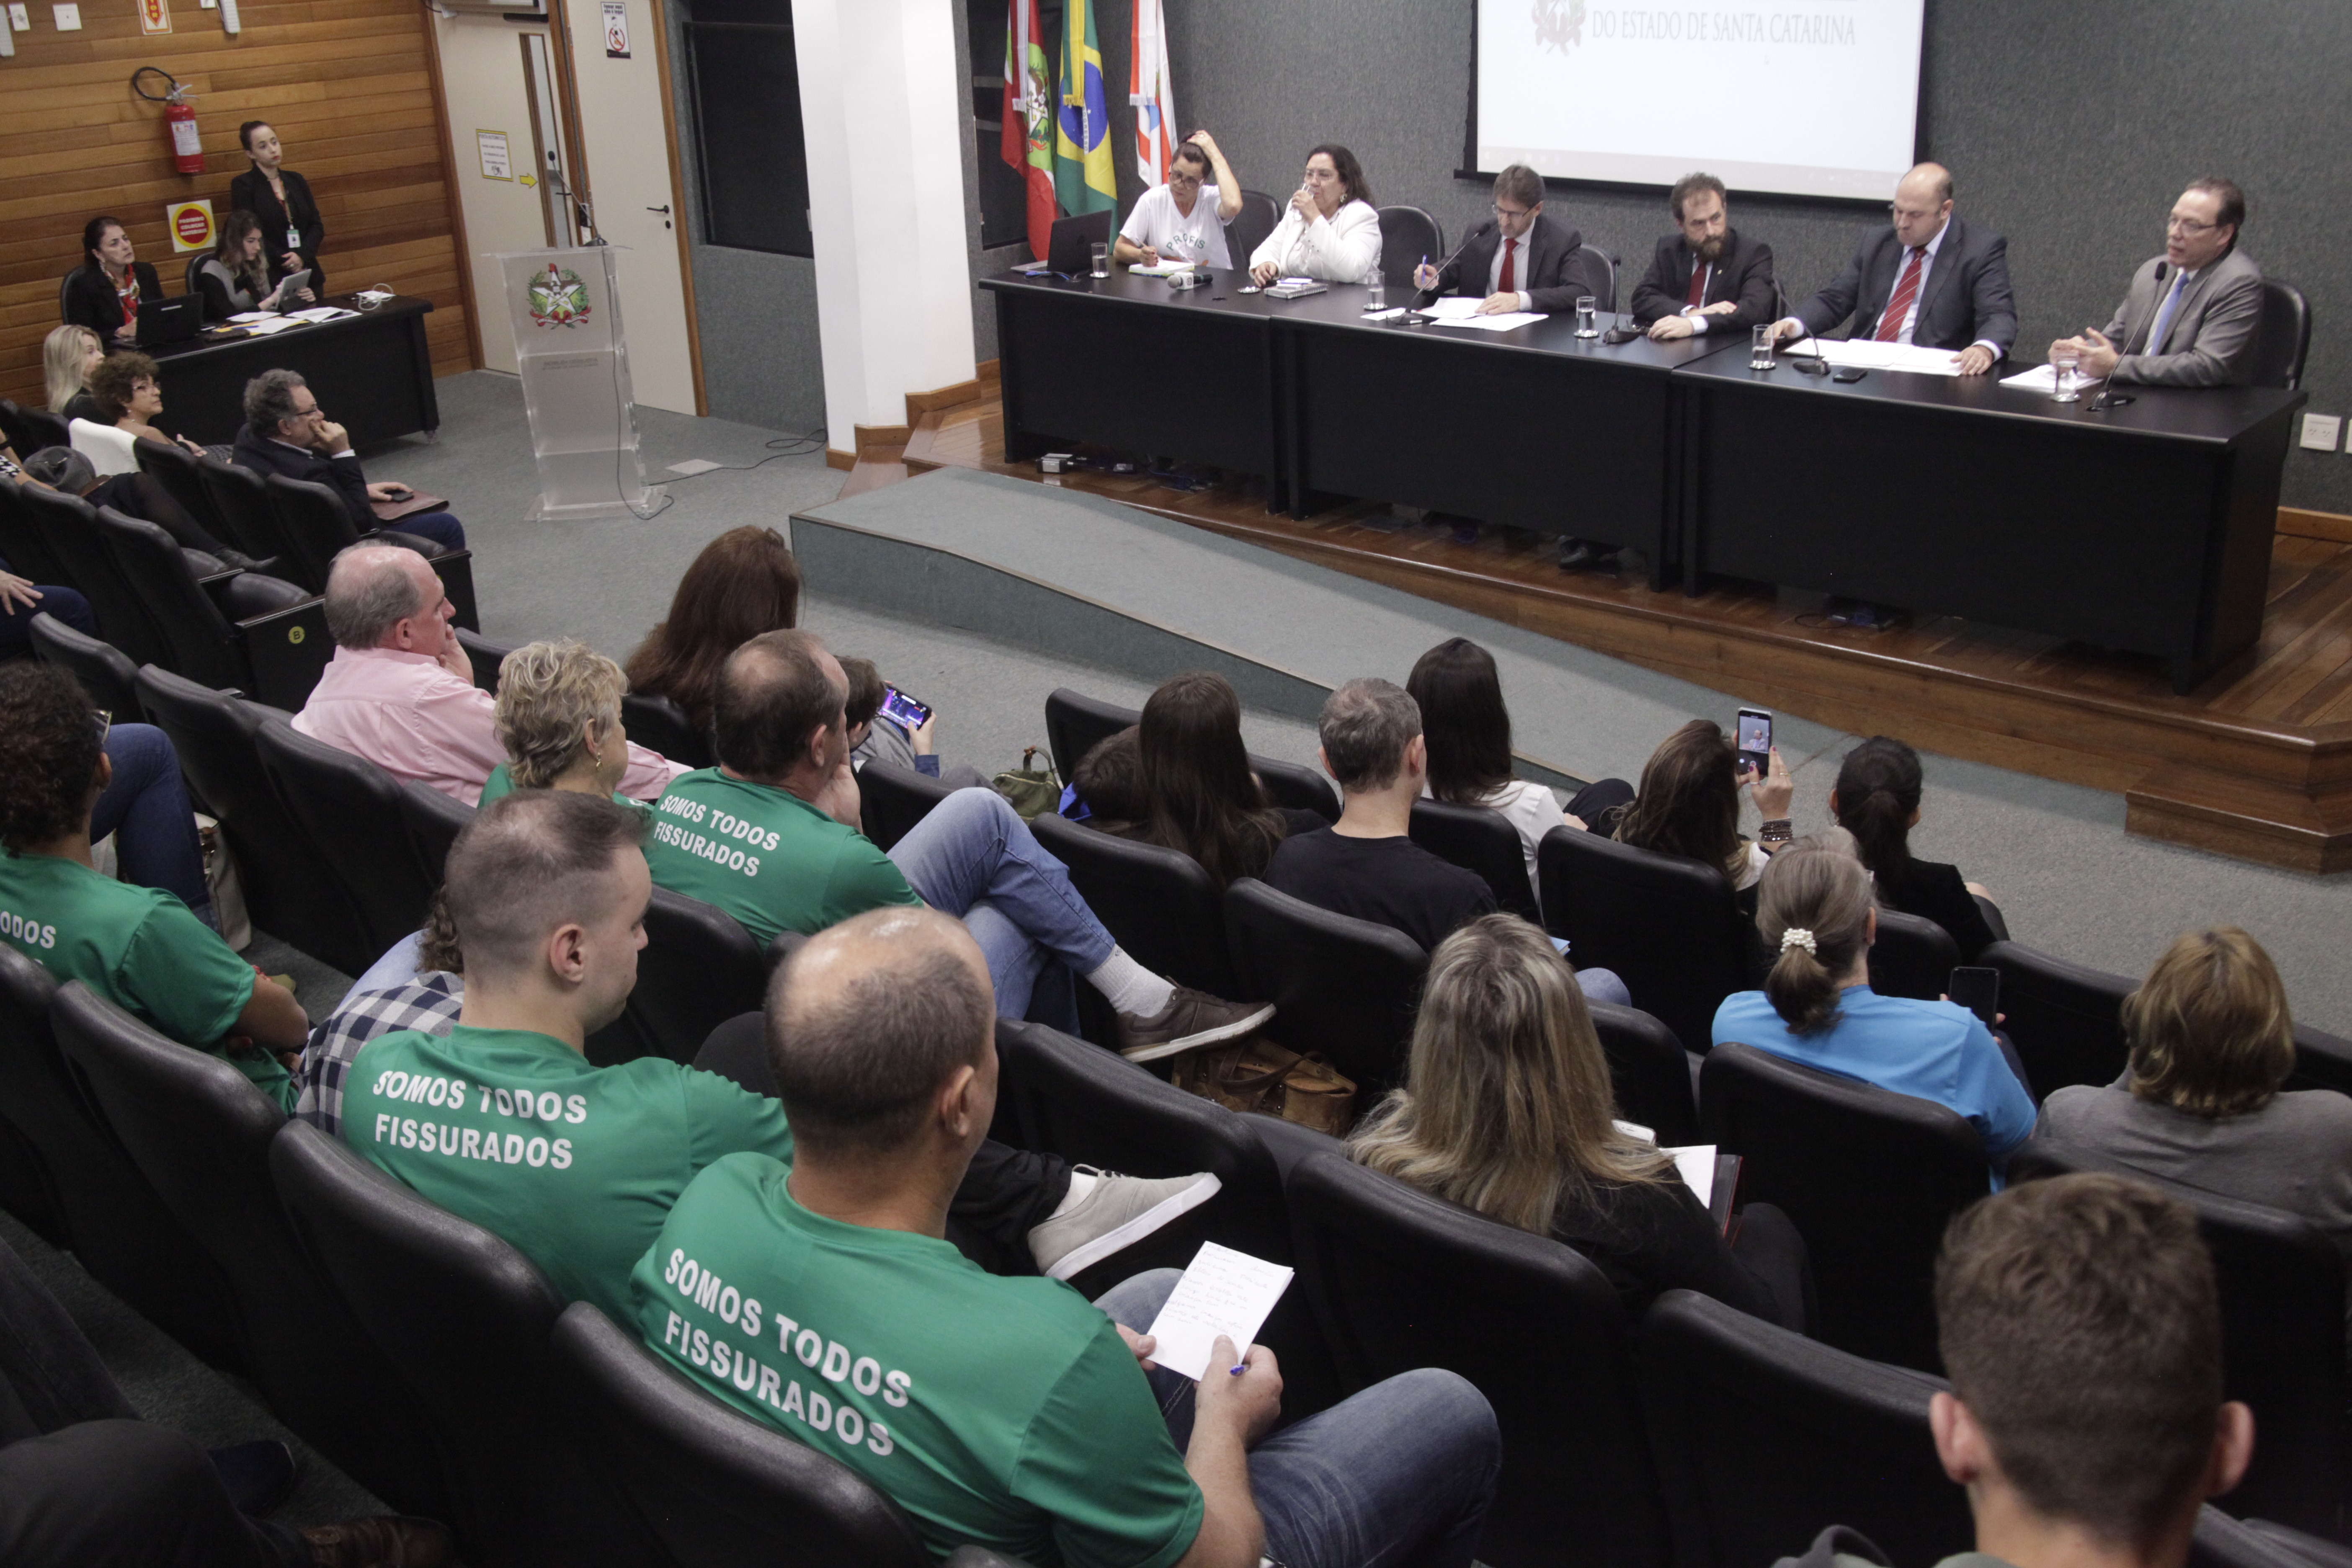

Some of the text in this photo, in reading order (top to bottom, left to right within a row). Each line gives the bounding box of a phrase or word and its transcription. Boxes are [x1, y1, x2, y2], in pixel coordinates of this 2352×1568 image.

[1592, 10, 1856, 44] DO ESTADO DE SANTA CATARINA
[1166, 233, 1206, 251] PROFIS
[294, 631, 300, 640] B
[653, 821, 760, 876] FISSURADOS
[660, 794, 780, 851] SOMOS TODOS
[0, 911, 57, 949] ODOS
[373, 1070, 587, 1123] SOMOS TODOS
[375, 1113, 573, 1169] FISSURADOS
[665, 1248, 911, 1408] SOMOS TODOS
[665, 1310, 894, 1456] FISSURADOS
